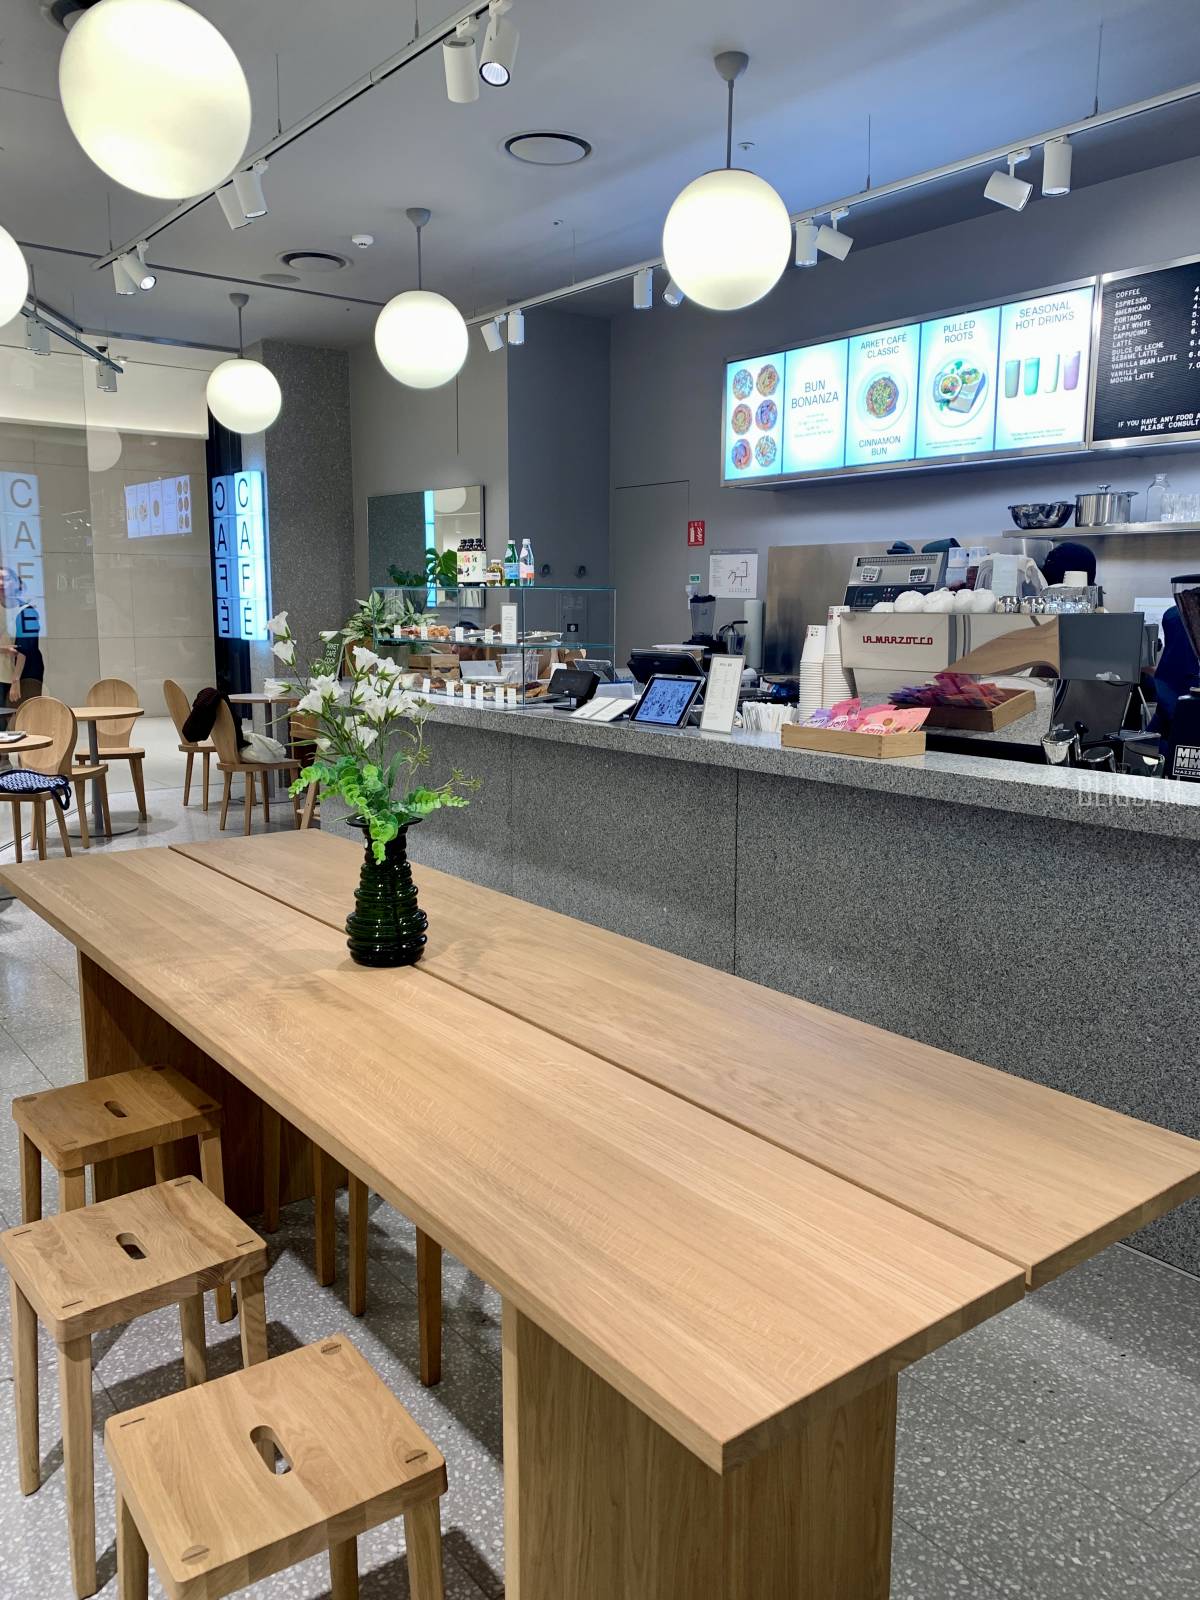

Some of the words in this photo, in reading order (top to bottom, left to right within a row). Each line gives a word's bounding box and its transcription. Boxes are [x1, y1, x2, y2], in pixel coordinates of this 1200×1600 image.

[1115, 288, 1141, 299] COFFEE
[1115, 296, 1148, 308] ESPRESSO
[1019, 300, 1071, 319] SEASONAL
[1114, 304, 1152, 316] AMERICANO
[1015, 319, 1035, 331] HOT
[1038, 311, 1074, 327] DRINKS
[1114, 313, 1142, 325] CORTADO
[943, 319, 976, 334] PULLED
[1113, 324, 1130, 333] FLAT
[1131, 320, 1152, 330] WHITE
[860, 338, 884, 350] ARKET
[886, 331, 908, 346] CAFÉ
[944, 331, 974, 344] ROOTS
[1113, 328, 1148, 340] CAPPUCINO
[1111, 347, 1133, 356] DULCE
[1134, 345, 1142, 353] DE
[1144, 341, 1164, 351] LECHE
[1112, 339, 1133, 348] LATTE
[867, 346, 900, 359] CLASSIC
[1111, 353, 1137, 362] SESAME
[1138, 348, 1158, 358] LATTE
[1111, 361, 1138, 370] VANILLA
[1139, 357, 1156, 366] BEAN
[1157, 353, 1178, 363] LATTE
[1110, 368, 1138, 377] VANILLA
[1110, 375, 1133, 384] MOCHA
[1134, 371, 1155, 381] LATTE
[804, 379, 826, 393] BUN
[791, 391, 839, 409] BONANZA
[1126, 419, 1139, 427] YOU
[1141, 417, 1158, 425] HAVE
[1160, 415, 1174, 423] ANY
[1175, 413, 1194, 421] FOOD
[1140, 423, 1165, 432] PLEASE
[1168, 419, 1199, 429] CONSULT
[858, 435, 902, 448] CINNAMON
[871, 447, 888, 457] BUN
[237, 477, 253, 636] CAFÉ
